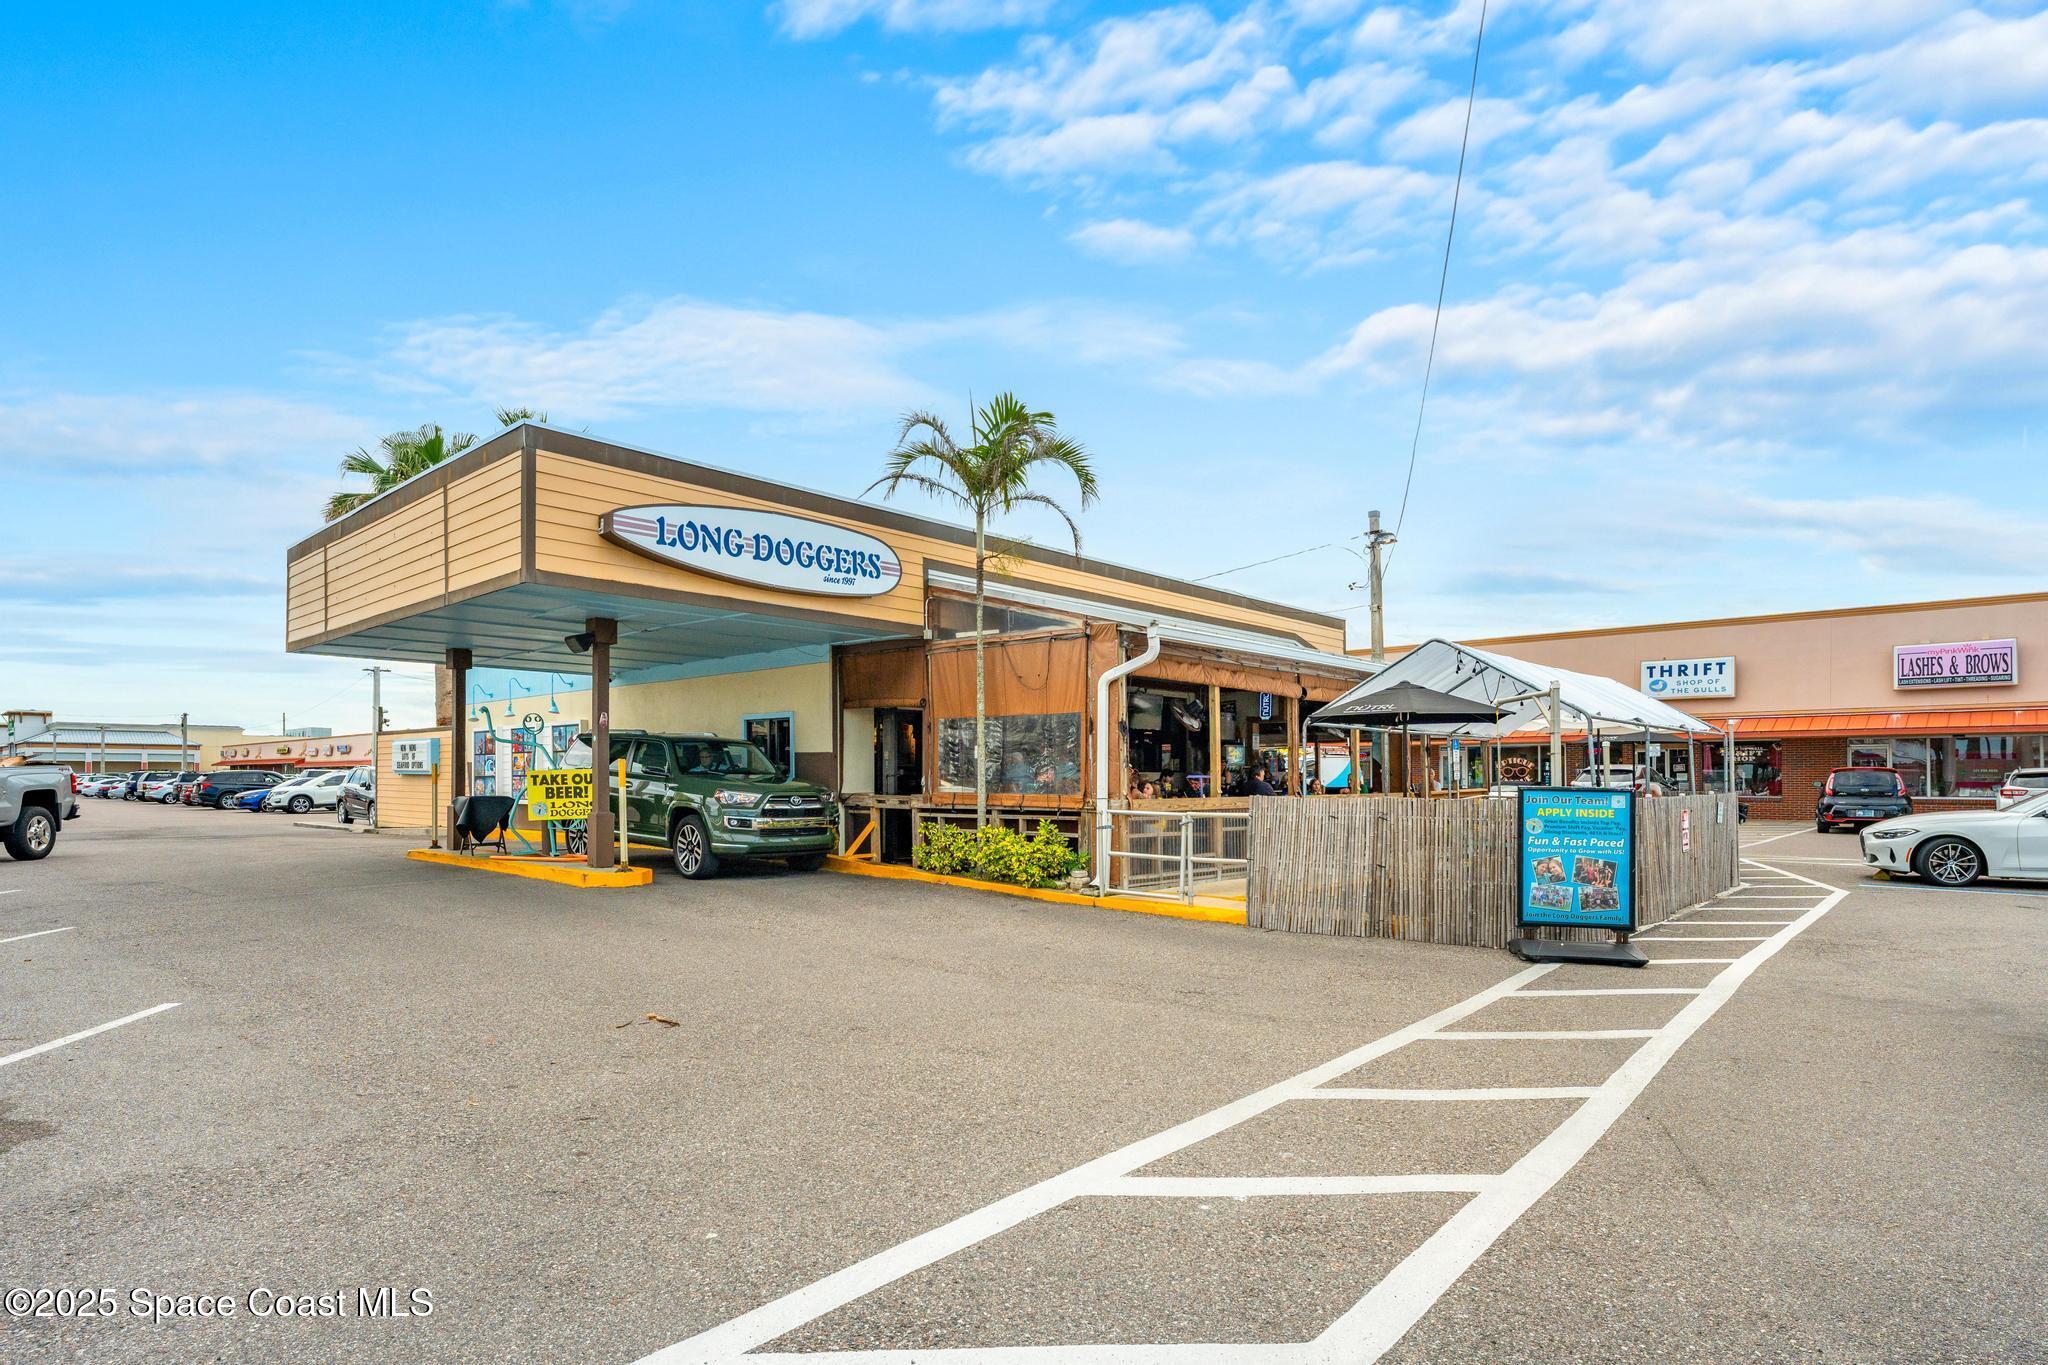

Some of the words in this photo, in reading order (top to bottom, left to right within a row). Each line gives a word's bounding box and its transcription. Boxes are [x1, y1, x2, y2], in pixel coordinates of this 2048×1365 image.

[656, 516, 745, 557] LONG
[752, 533, 882, 579] DOGGERS
[823, 574, 841, 584] since
[841, 577, 856, 586] 1997
[1646, 662, 1726, 678] THRIFT
[1901, 656, 1943, 677] LASHES
[1949, 655, 1959, 675] &
[1965, 652, 2009, 674] BROWS
[531, 774, 568, 786] TAKE
[571, 773, 593, 785] OU
[545, 786, 589, 799] BEER!
[1526, 795, 1549, 804] Join
[1551, 796, 1573, 804] Our
[1575, 796, 1608, 805] Team!
[1537, 808, 1573, 817] APPLY
[1575, 809, 1615, 818] INSIDE
[1528, 836, 1549, 845] Fun
[1551, 837, 1560, 845] &
[1563, 837, 1587, 846] Fast
[1590, 838, 1624, 847] Paced
